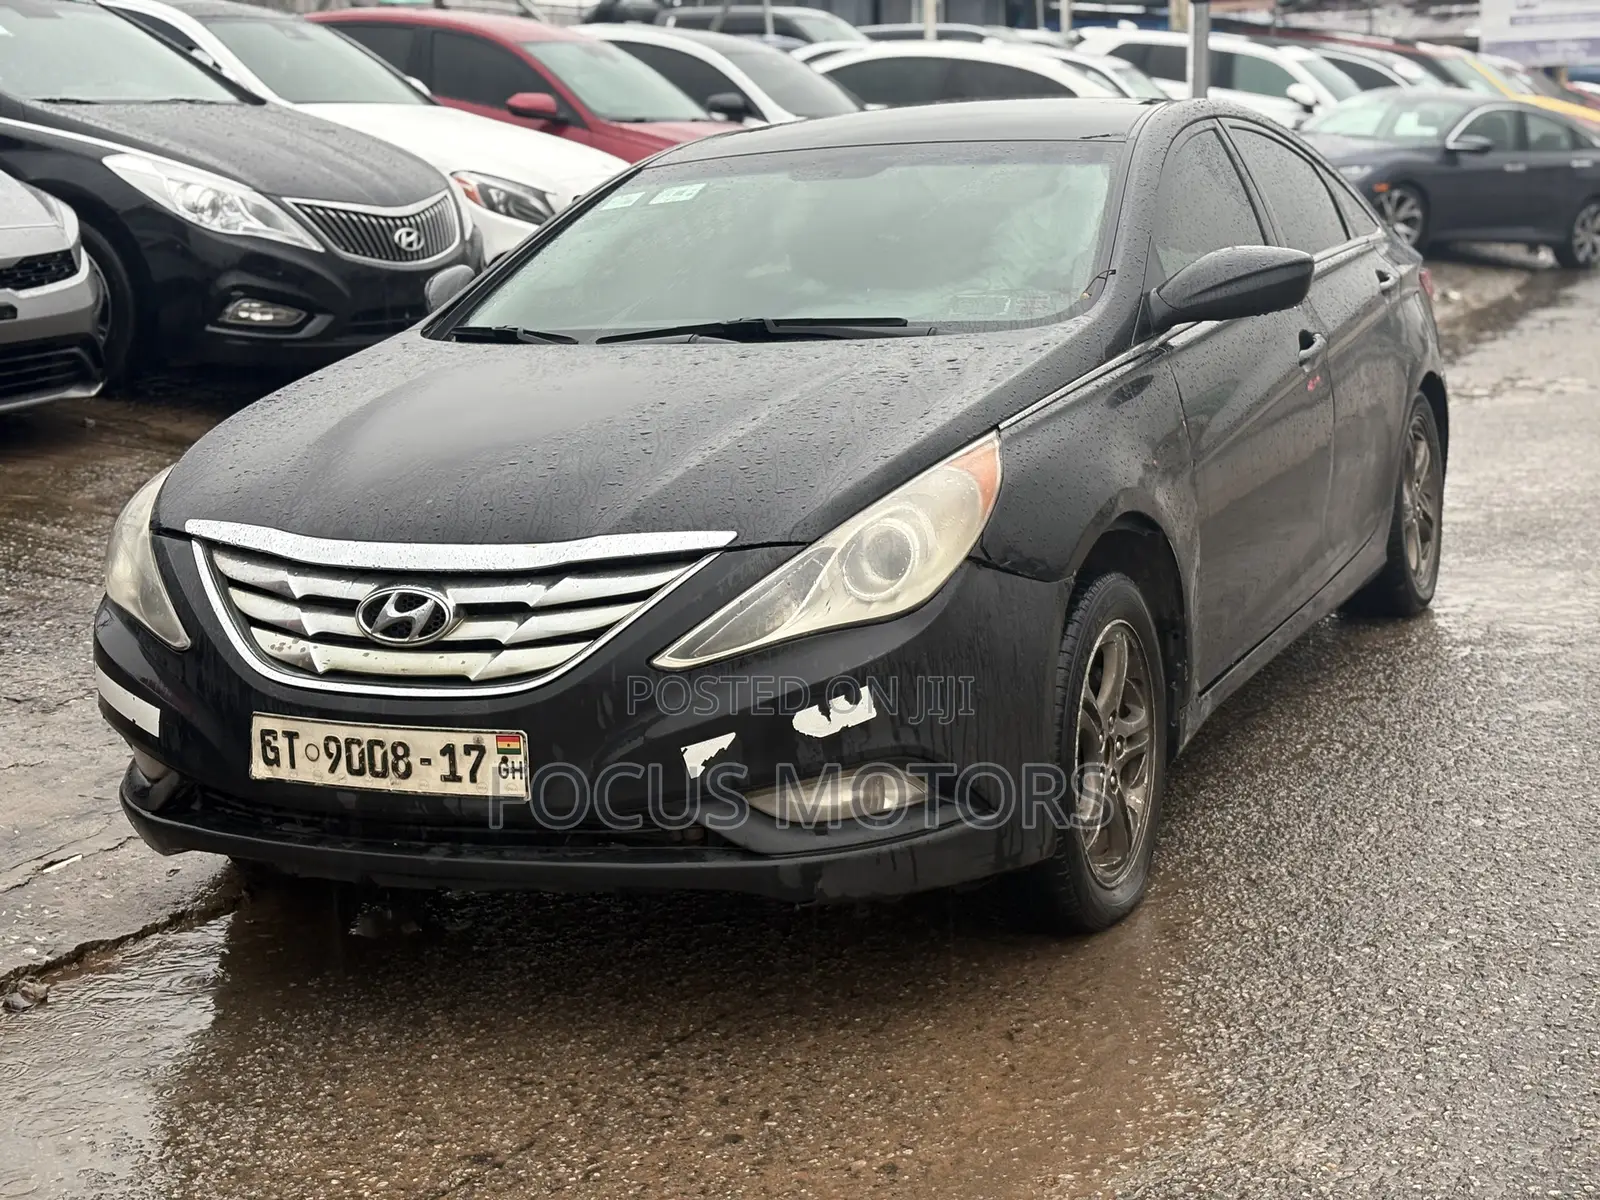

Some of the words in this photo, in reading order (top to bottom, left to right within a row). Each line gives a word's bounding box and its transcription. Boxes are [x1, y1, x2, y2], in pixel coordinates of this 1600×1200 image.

[259, 727, 301, 769] GT
[322, 735, 487, 784] 9008-17
[498, 758, 523, 780] GH
